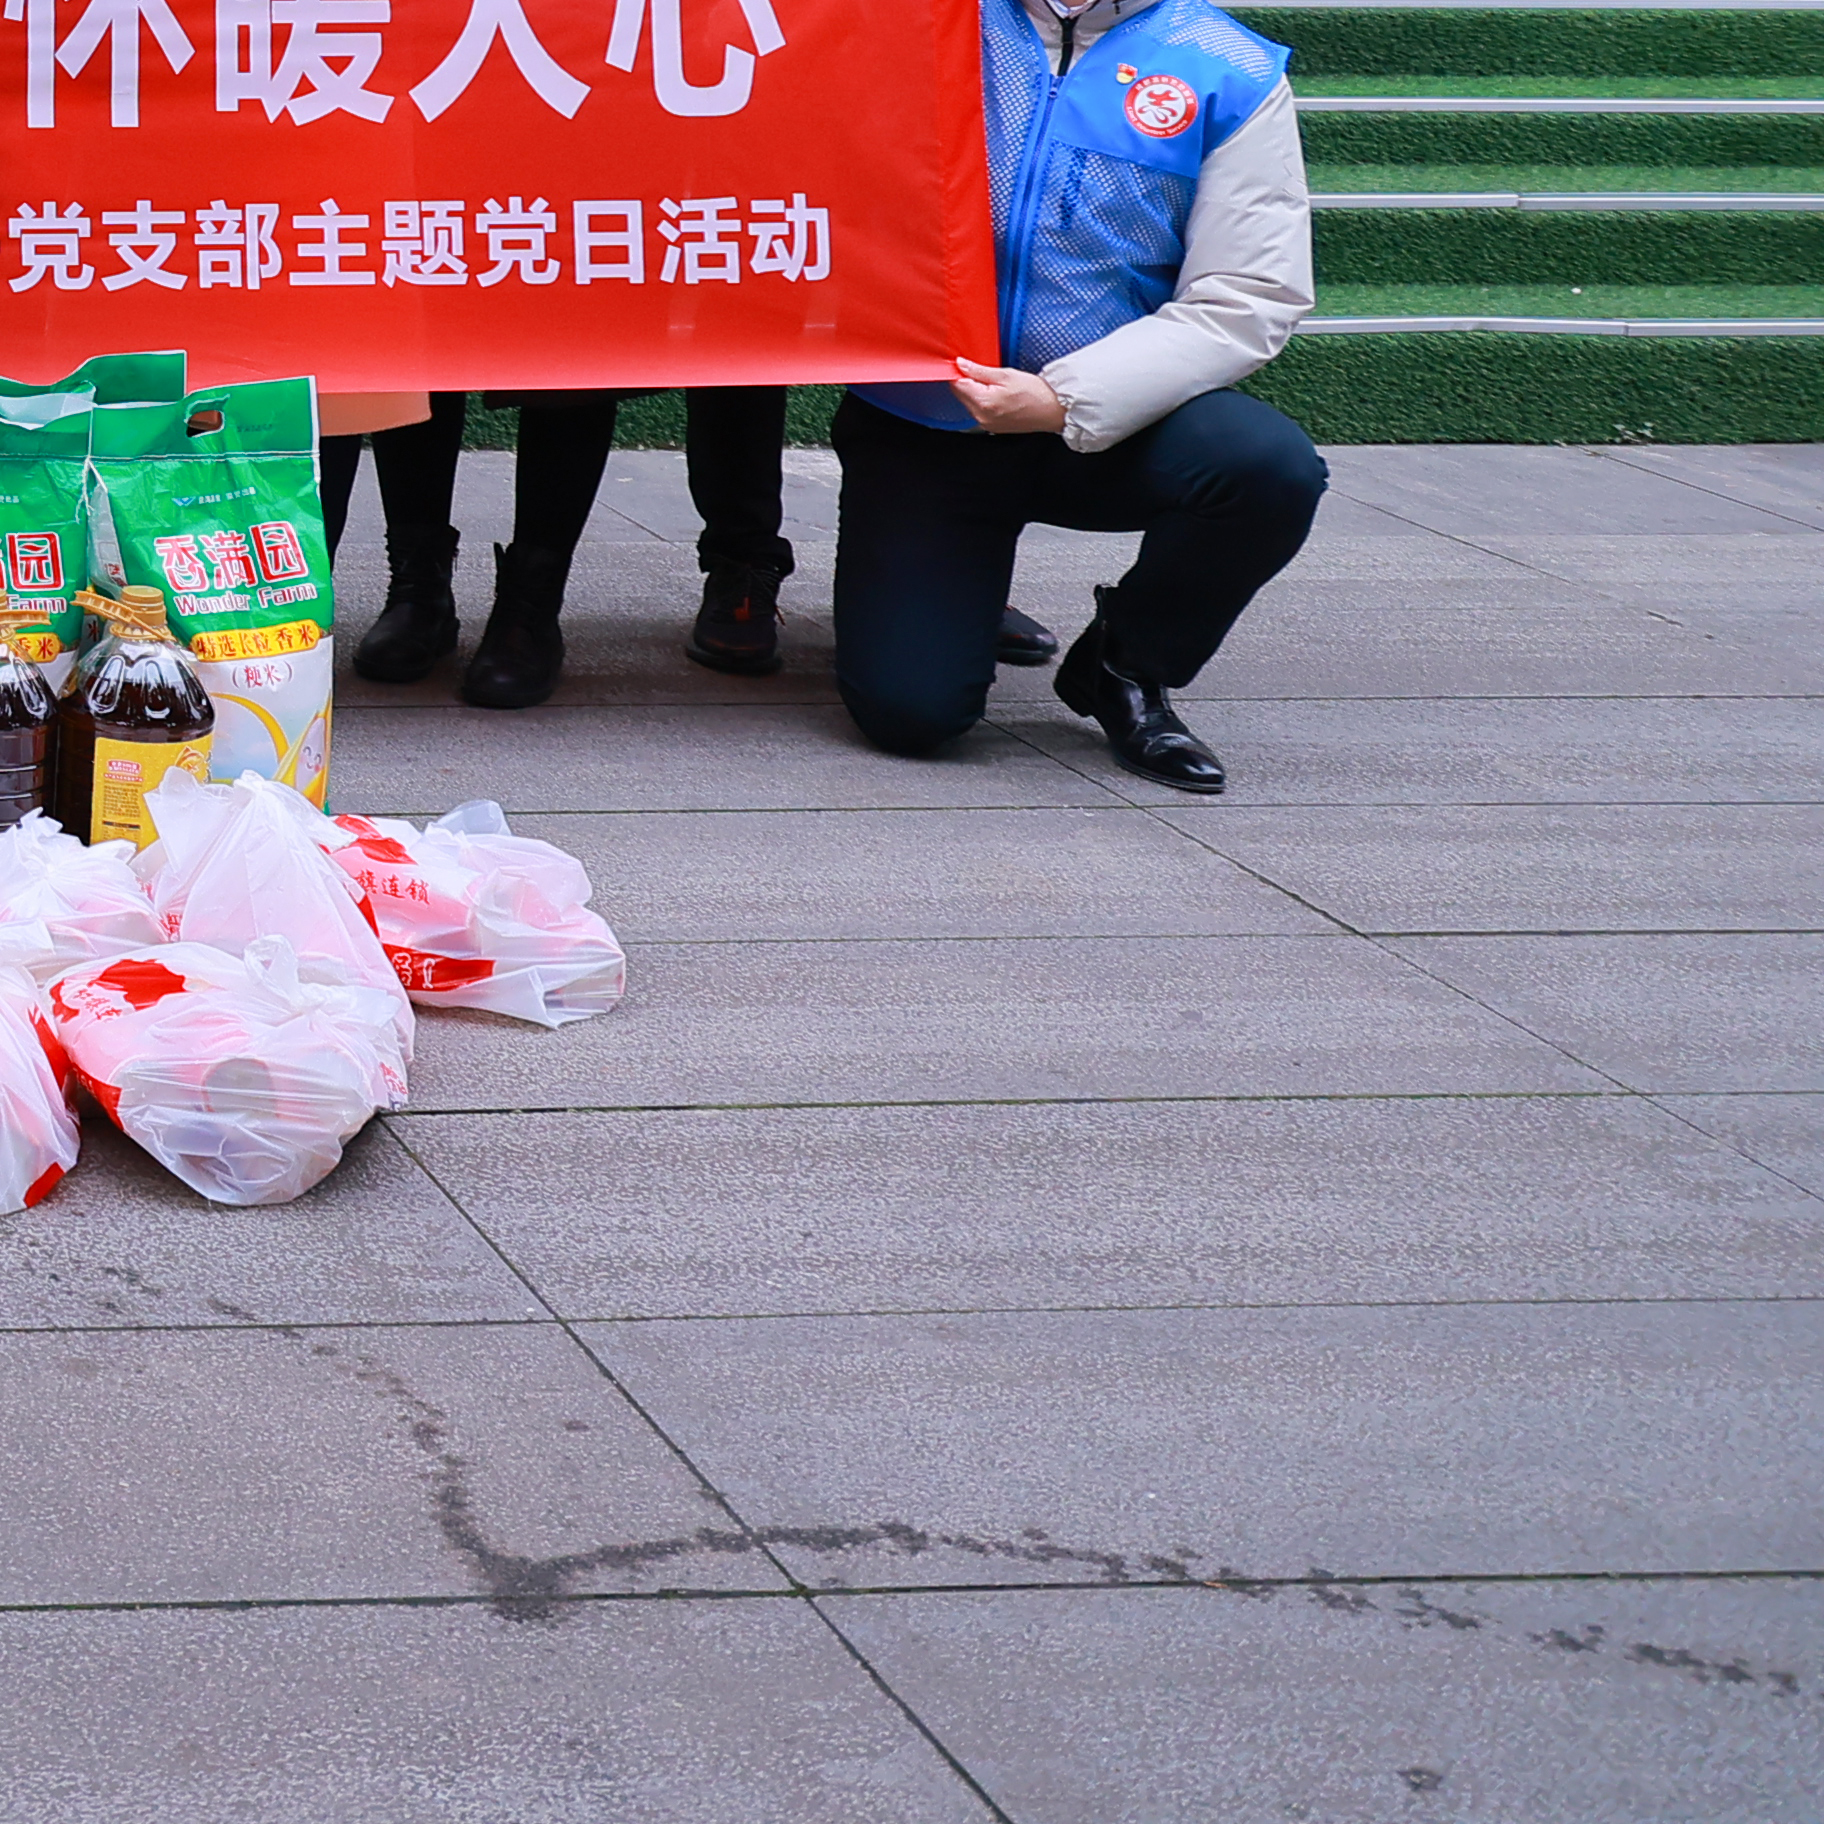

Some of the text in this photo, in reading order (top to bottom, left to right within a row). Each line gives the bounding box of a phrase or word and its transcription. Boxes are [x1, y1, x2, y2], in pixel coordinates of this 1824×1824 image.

[154, 520, 310, 594] 香满园
[174, 582, 317, 617] Wonder Farm
[195, 623, 316, 660] 特选长粒香米
[354, 869, 431, 906] 旗连锁
